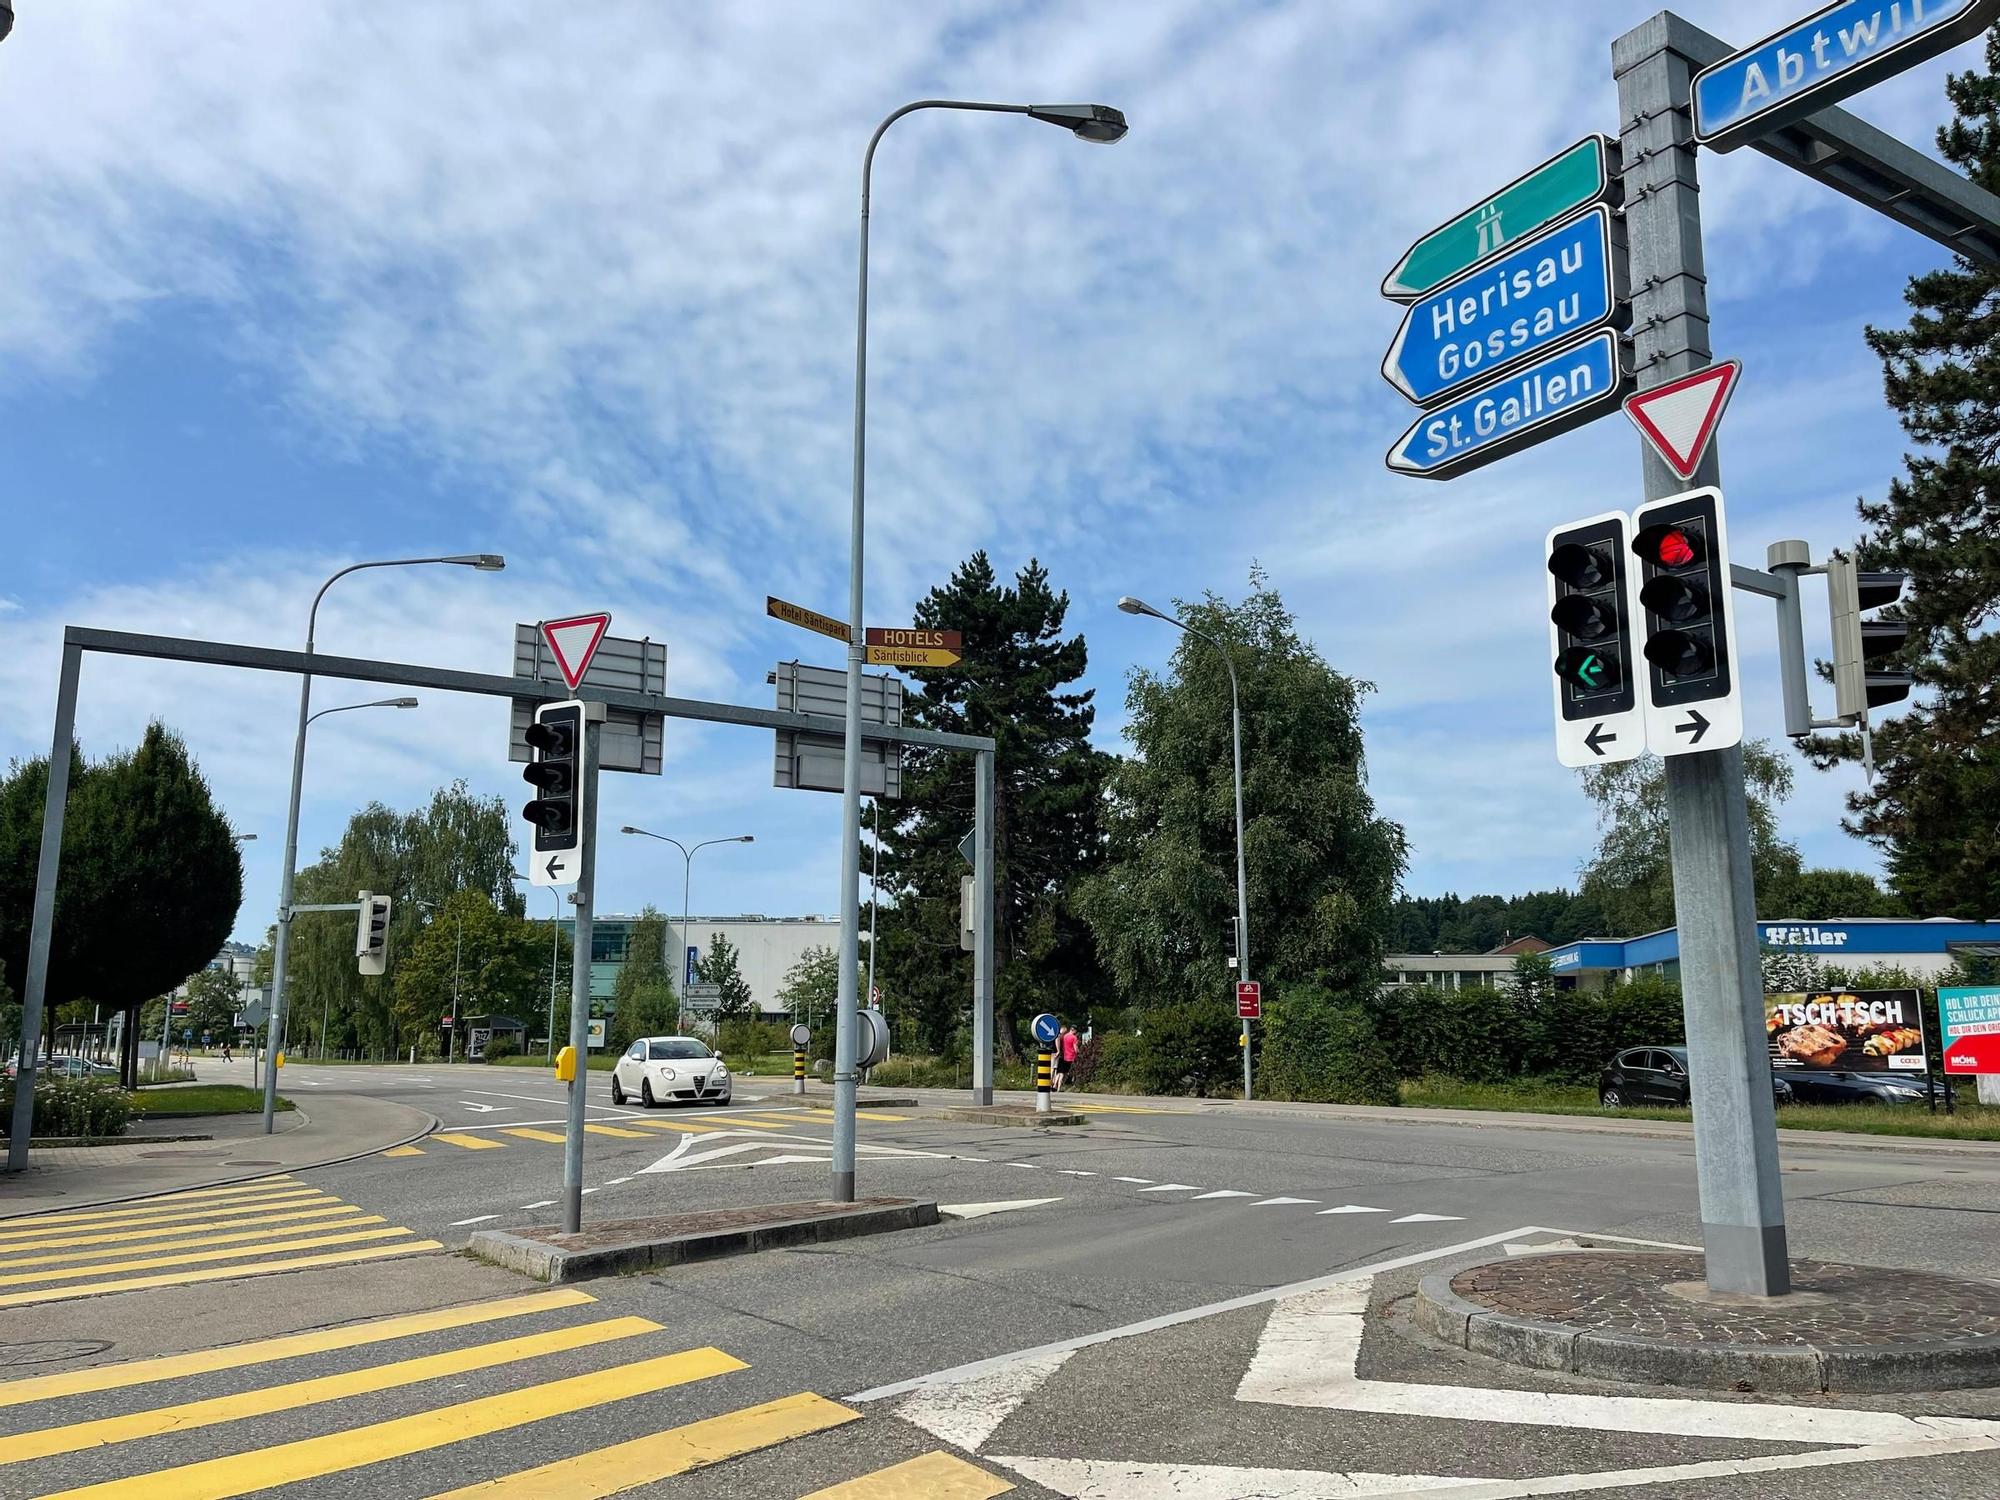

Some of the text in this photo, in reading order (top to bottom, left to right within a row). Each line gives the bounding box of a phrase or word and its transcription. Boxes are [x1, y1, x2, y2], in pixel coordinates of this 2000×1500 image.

[1740, 0, 1924, 110] Abtwil
[1432, 240, 1583, 341] Herisau
[1438, 290, 1580, 380] Gossau
[1426, 361, 1592, 459] St.Gallen
[781, 604, 847, 638] Hotel Säntispark
[884, 631, 944, 646] HOTELS
[873, 649, 928, 663] Säntisblick
[1777, 1000, 1903, 1026] TSCH TSCH
[1945, 998, 1962, 1010] HOL
[1963, 996, 1979, 1009] DIR
[1947, 1010, 1985, 1023] SCHLUCK
